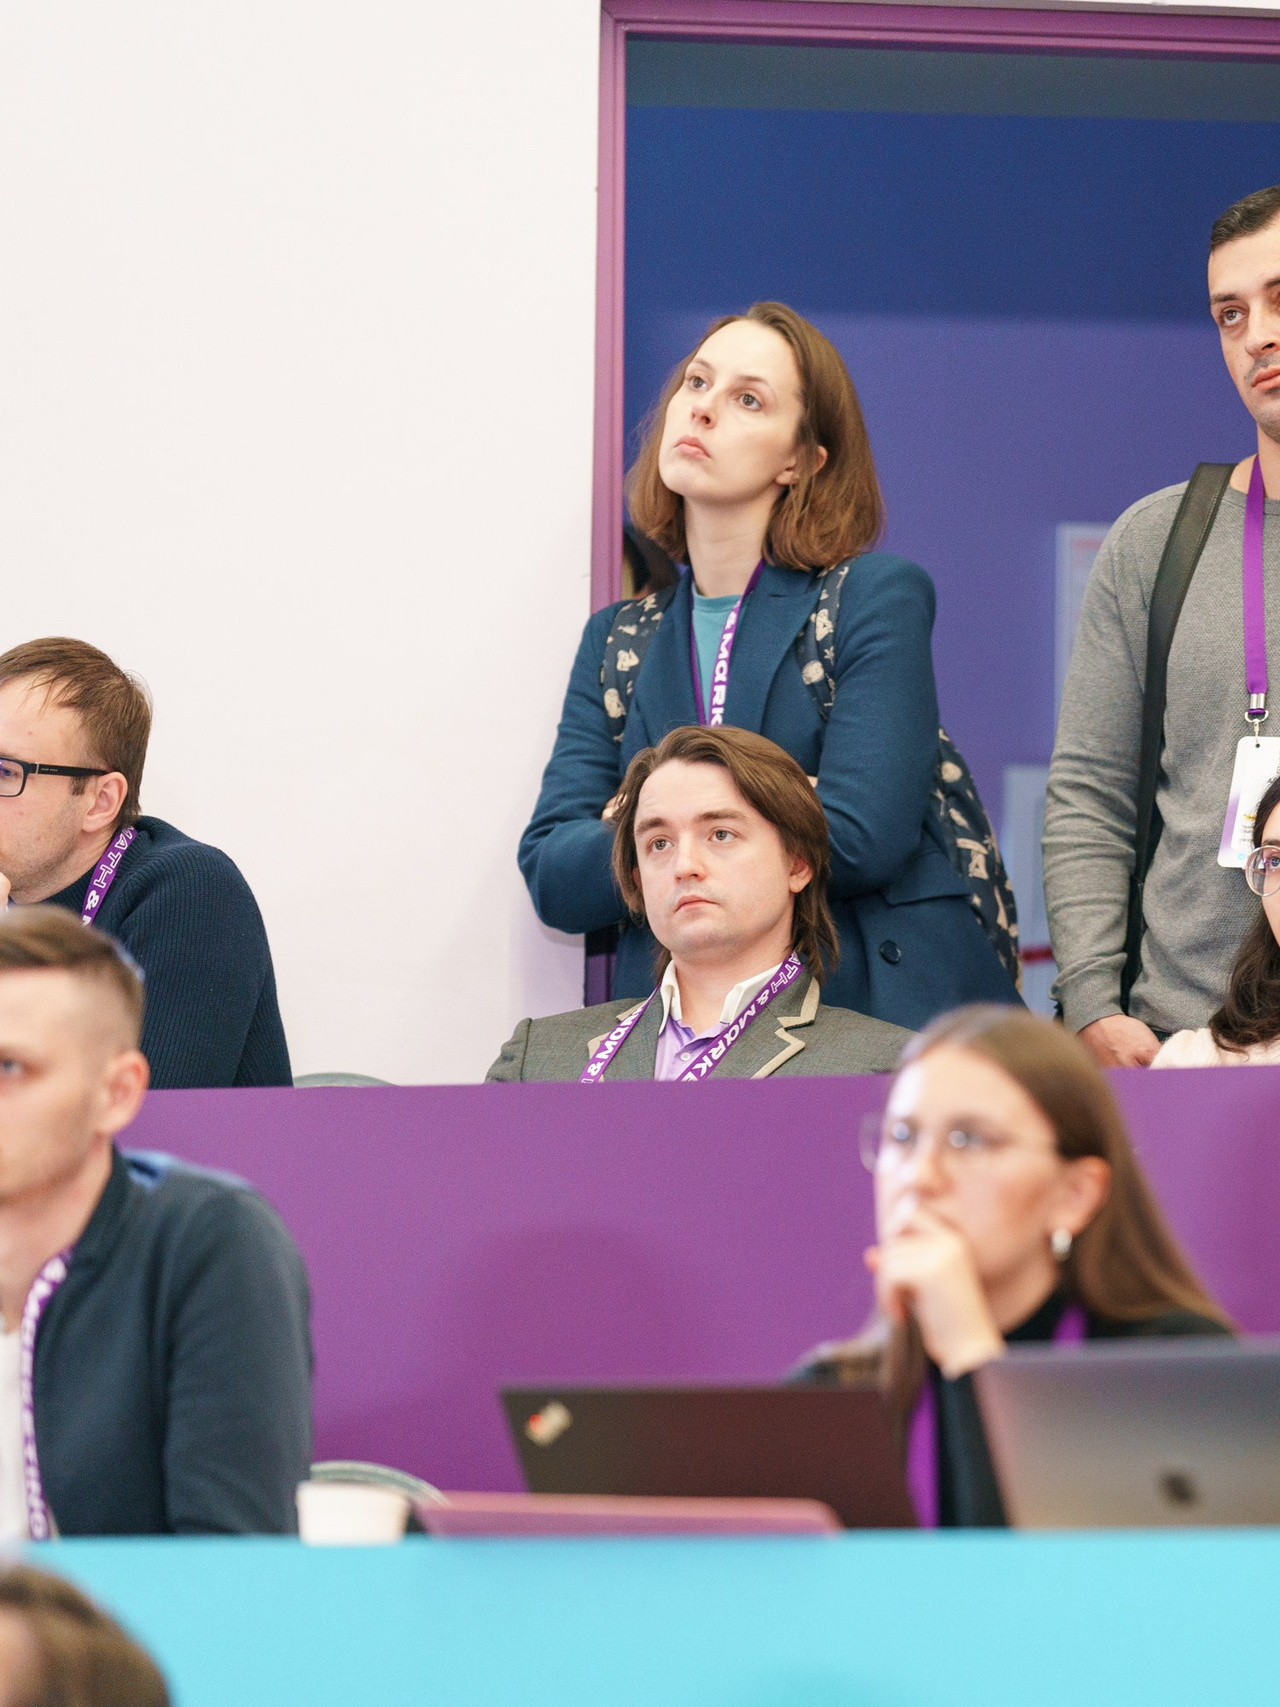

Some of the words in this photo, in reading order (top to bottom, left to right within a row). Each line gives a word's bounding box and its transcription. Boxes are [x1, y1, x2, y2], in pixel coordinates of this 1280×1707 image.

[85, 890, 100, 911] &
[756, 989, 770, 1006] &
[587, 1061, 605, 1077] &
